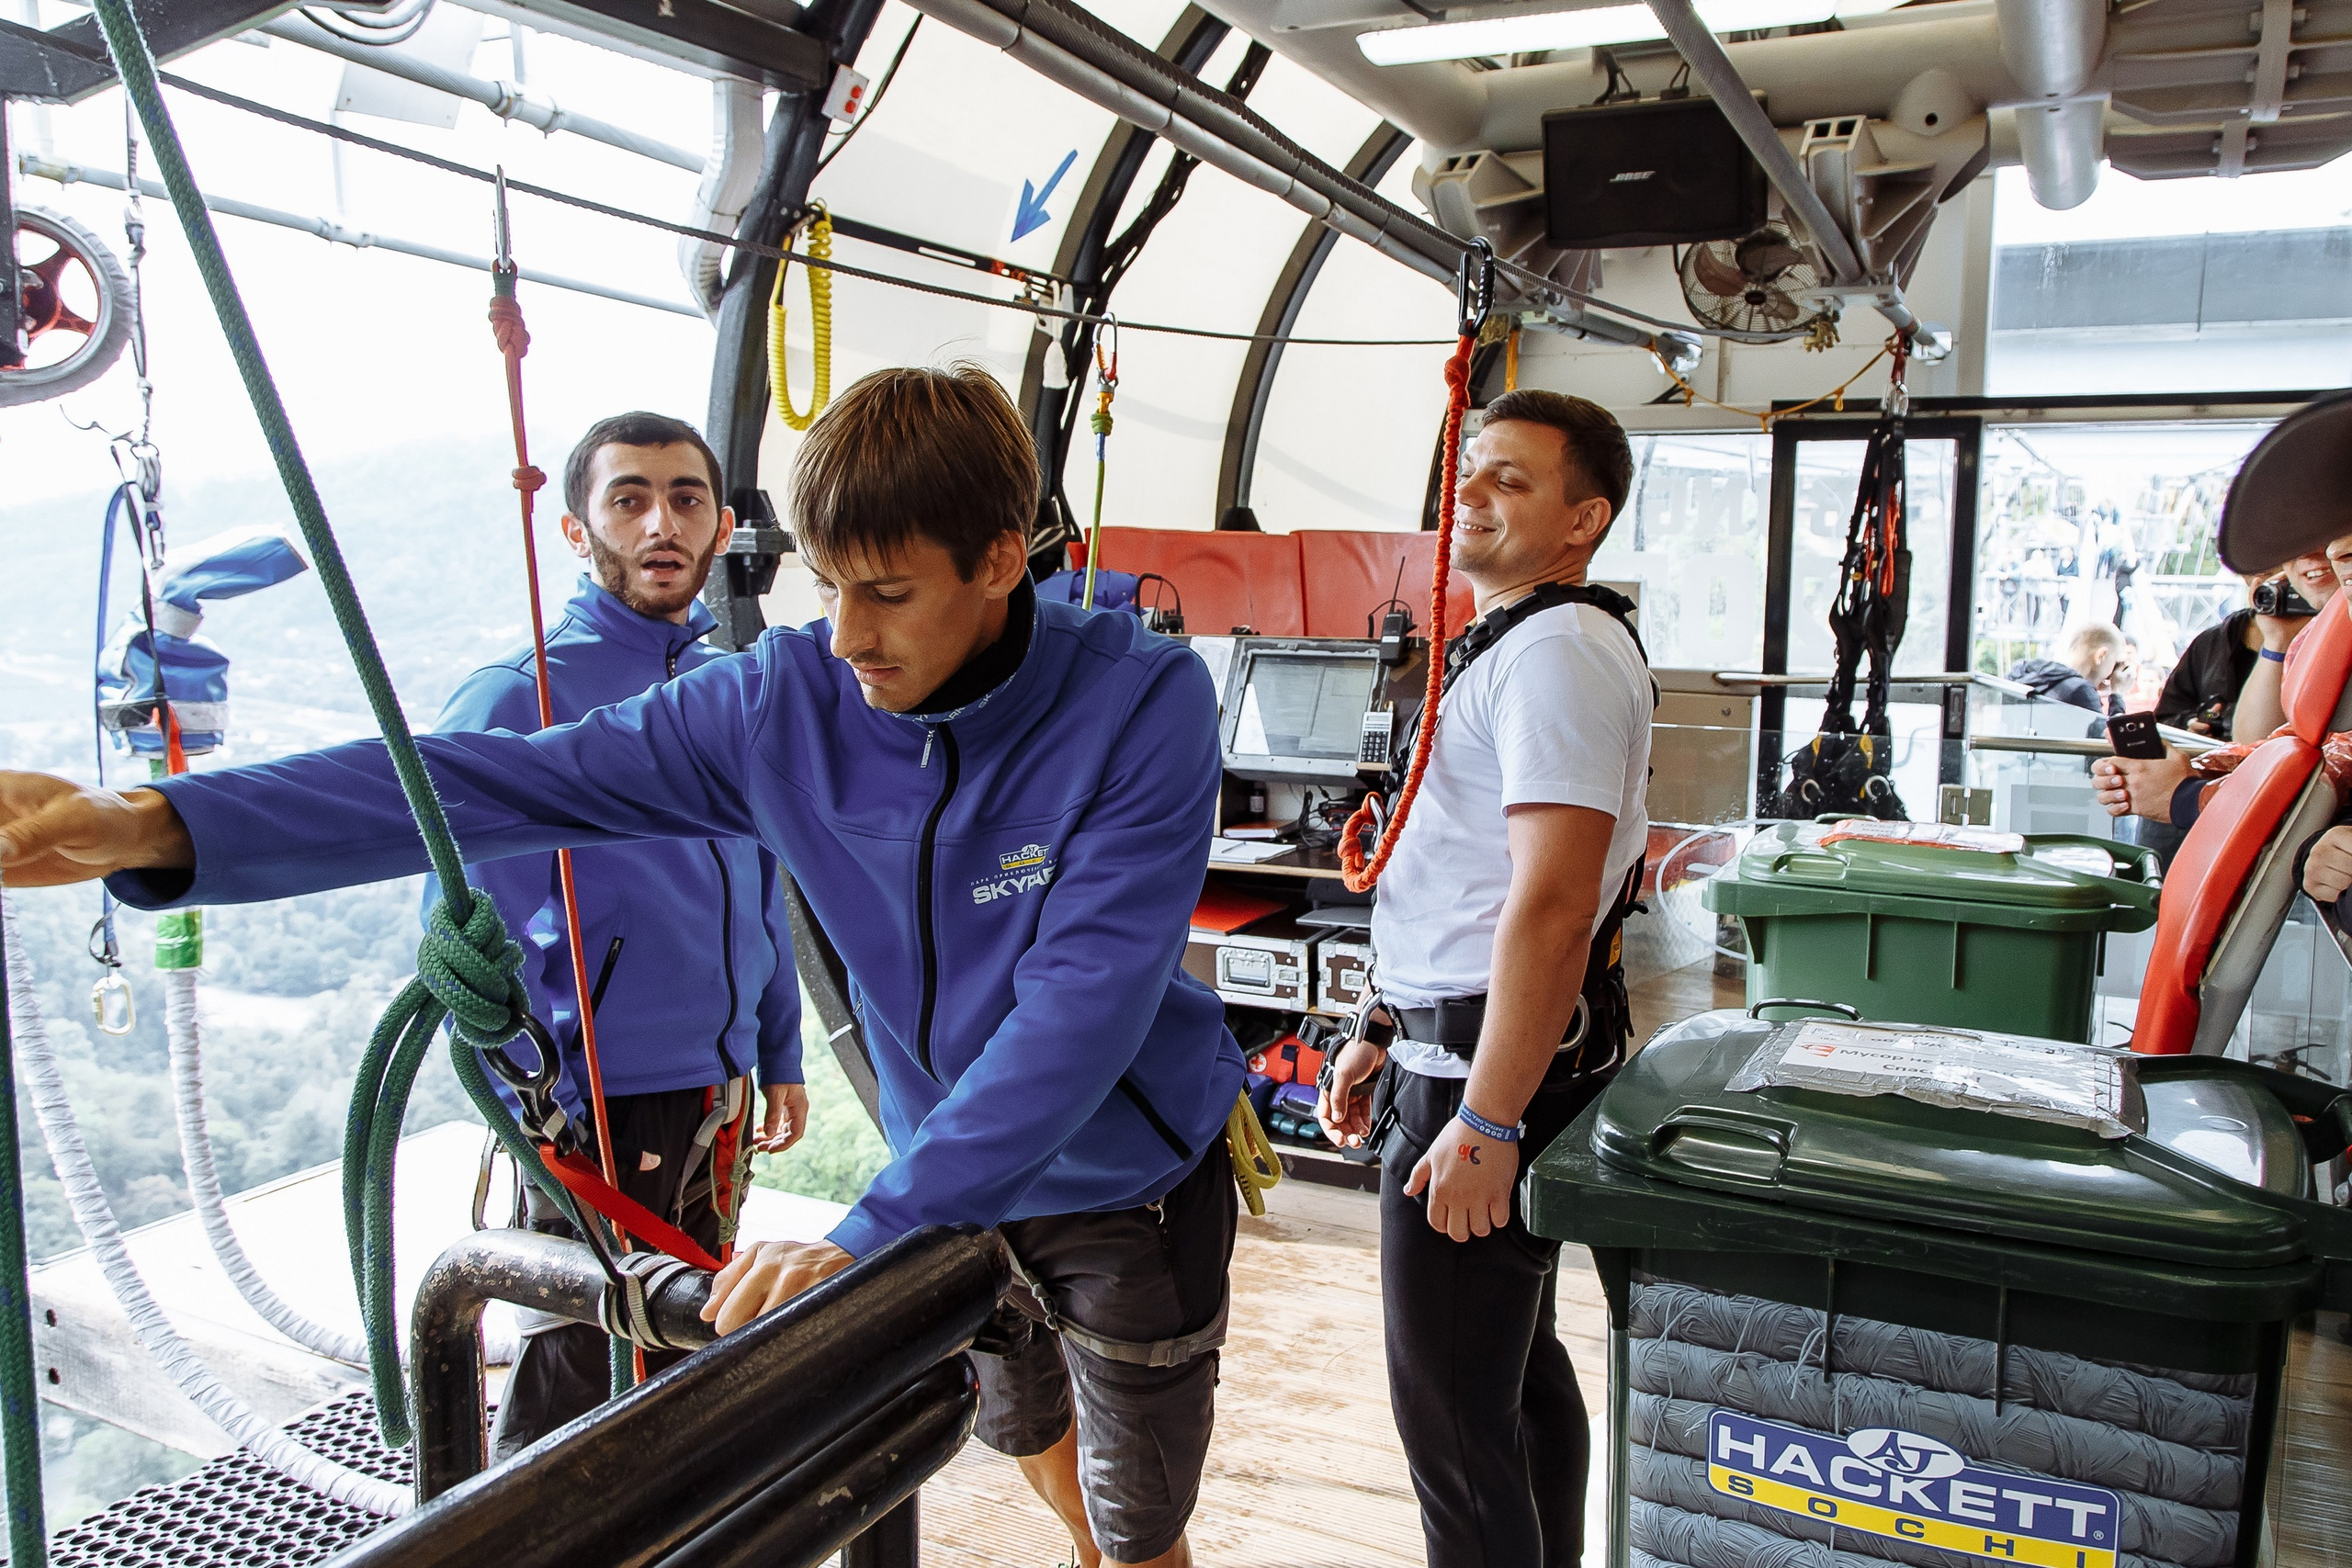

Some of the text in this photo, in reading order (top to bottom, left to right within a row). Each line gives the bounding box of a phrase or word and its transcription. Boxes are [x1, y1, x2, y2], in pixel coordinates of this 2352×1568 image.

[1001, 848, 1050, 863] HACKET
[1839, 1049, 1905, 1061] Мусор
[1716, 1424, 2108, 1540] HACKETT
[1727, 1473, 2086, 1568] SOCHI
